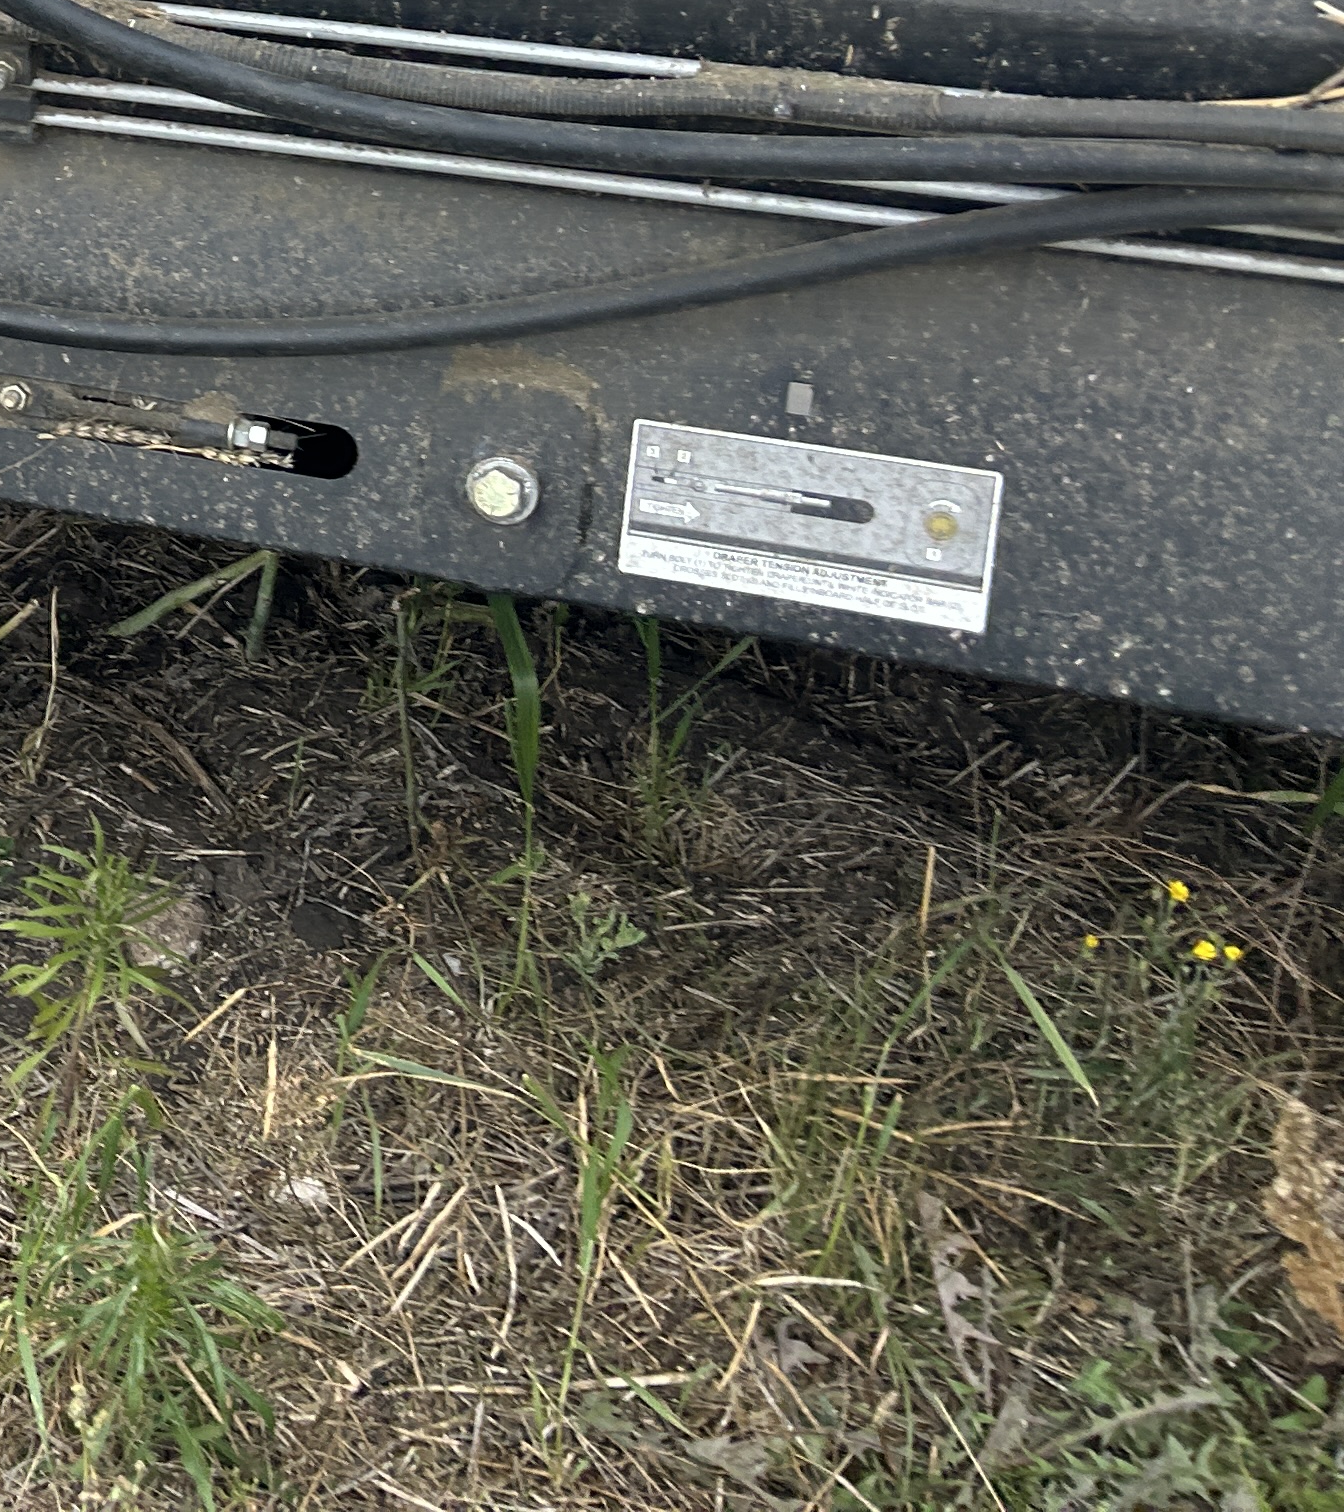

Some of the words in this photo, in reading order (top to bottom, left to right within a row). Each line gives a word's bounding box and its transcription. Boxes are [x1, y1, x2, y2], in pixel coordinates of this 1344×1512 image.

[712, 551, 759, 565] DRAPER
[760, 559, 810, 574] TENSION
[812, 567, 887, 587] ADJUSTMENT
